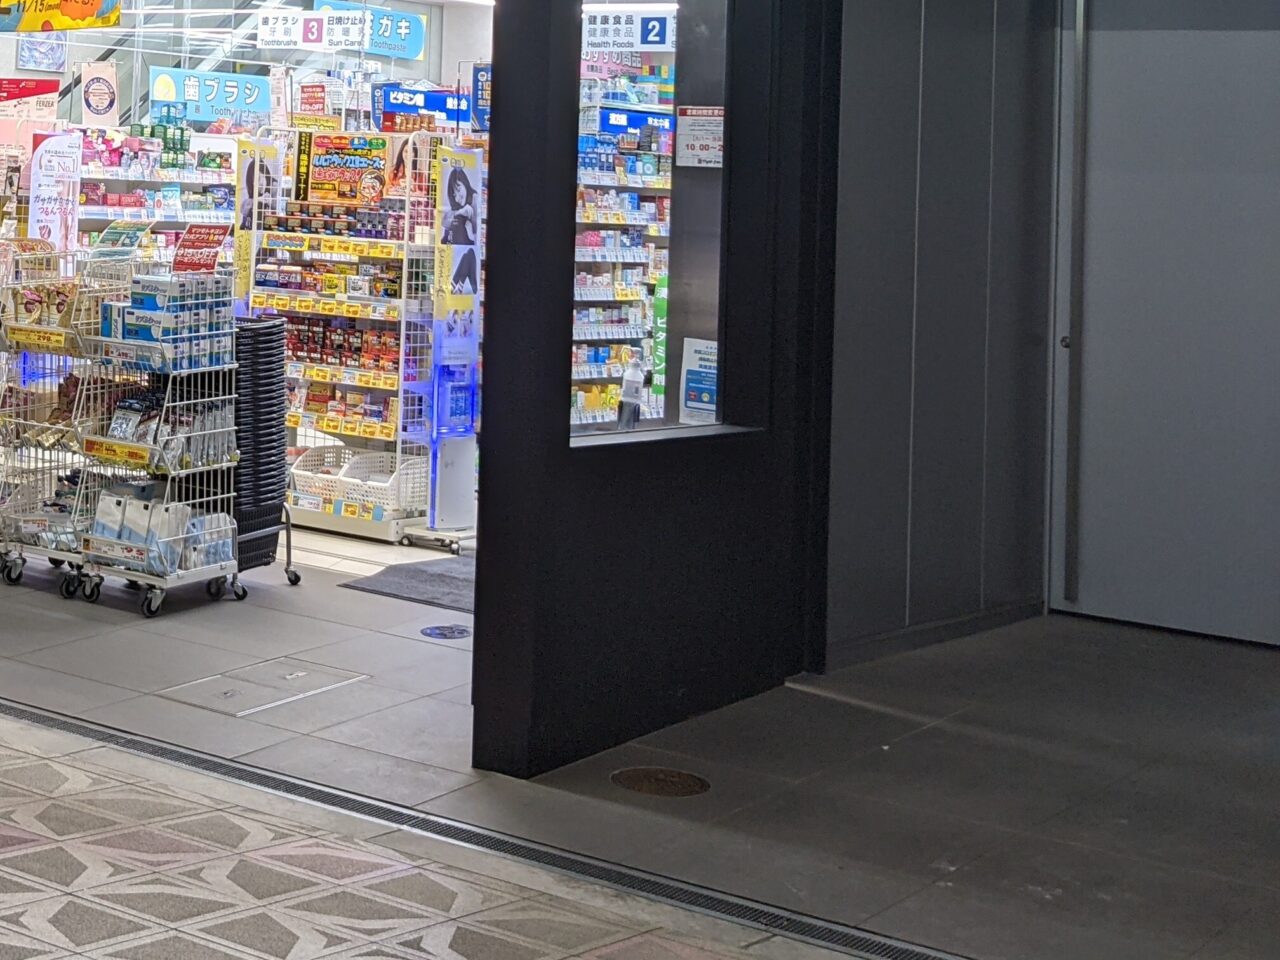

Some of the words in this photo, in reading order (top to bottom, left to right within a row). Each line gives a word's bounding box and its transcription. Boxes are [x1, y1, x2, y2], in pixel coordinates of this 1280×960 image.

[308, 21, 318, 40] 3
[646, 20, 661, 42] 2
[327, 39, 342, 47] Sun
[587, 40, 611, 49] Health
[612, 40, 634, 49] Foods
[183, 75, 261, 105] 歯ブラシ
